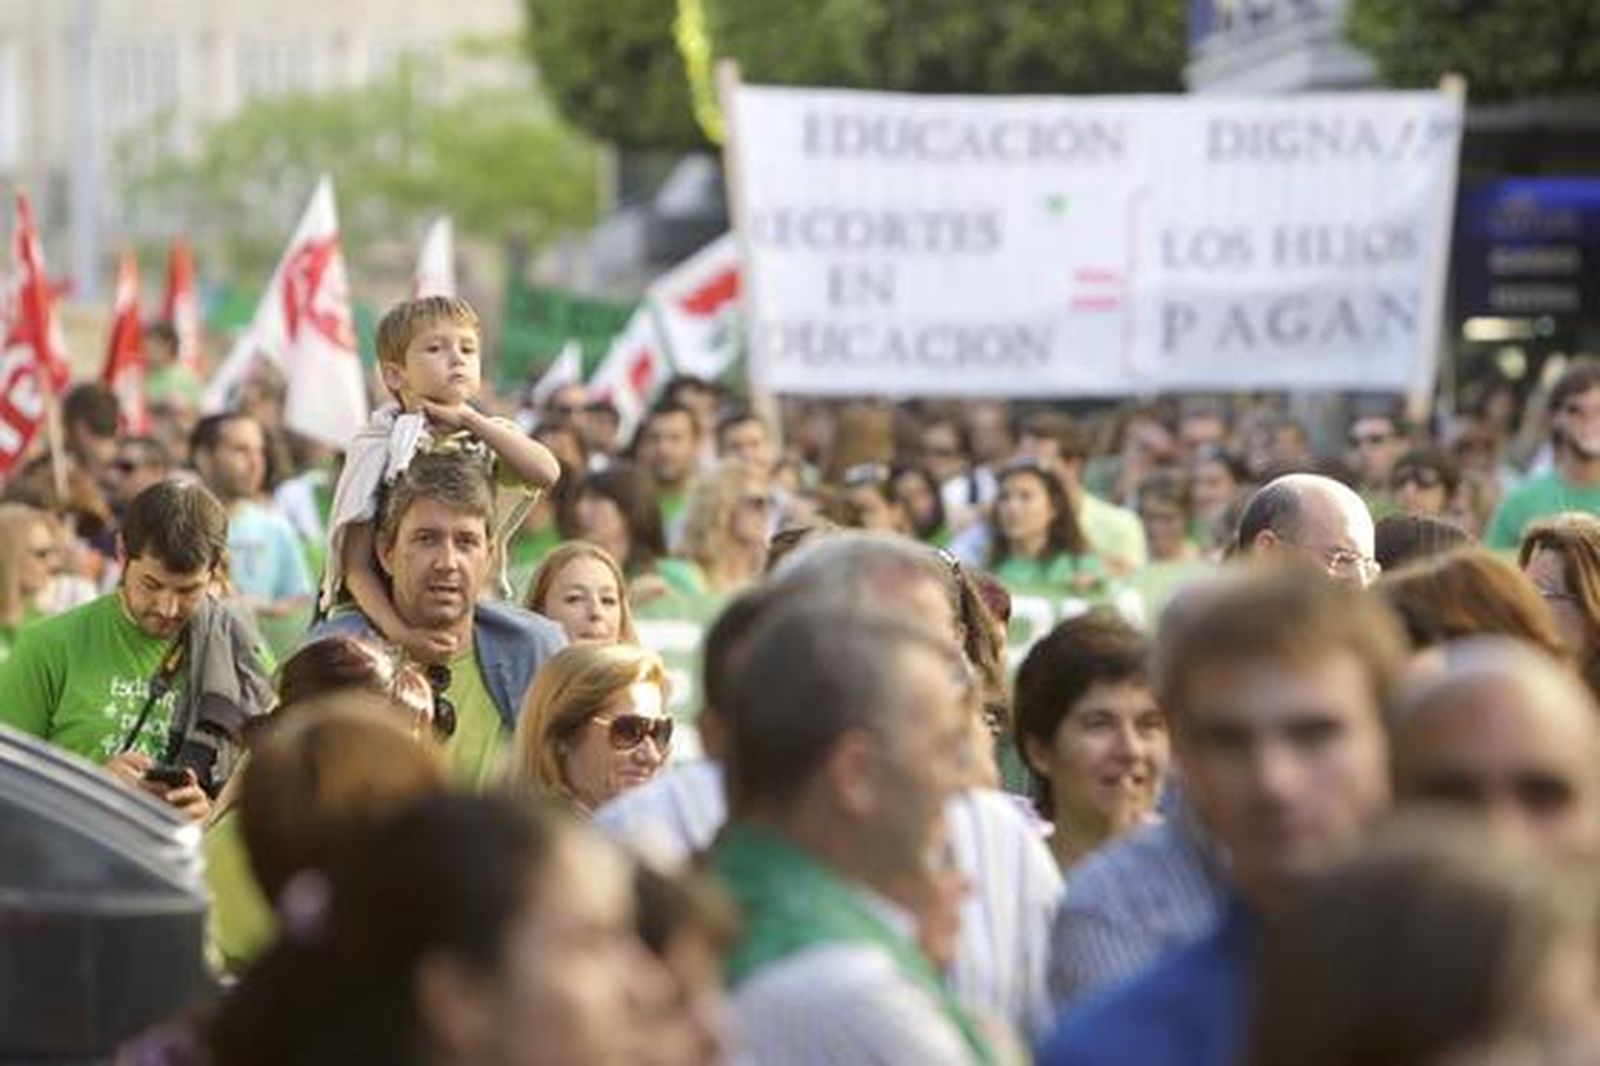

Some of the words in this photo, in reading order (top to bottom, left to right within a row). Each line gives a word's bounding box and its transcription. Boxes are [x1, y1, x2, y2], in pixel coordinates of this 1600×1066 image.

[1159, 227, 1255, 269] LOS
[1272, 225, 1415, 267] HIJOS
[826, 264, 895, 307] EN
[762, 322, 1054, 366] DUCACION
[1159, 293, 1418, 354] PAGAN
